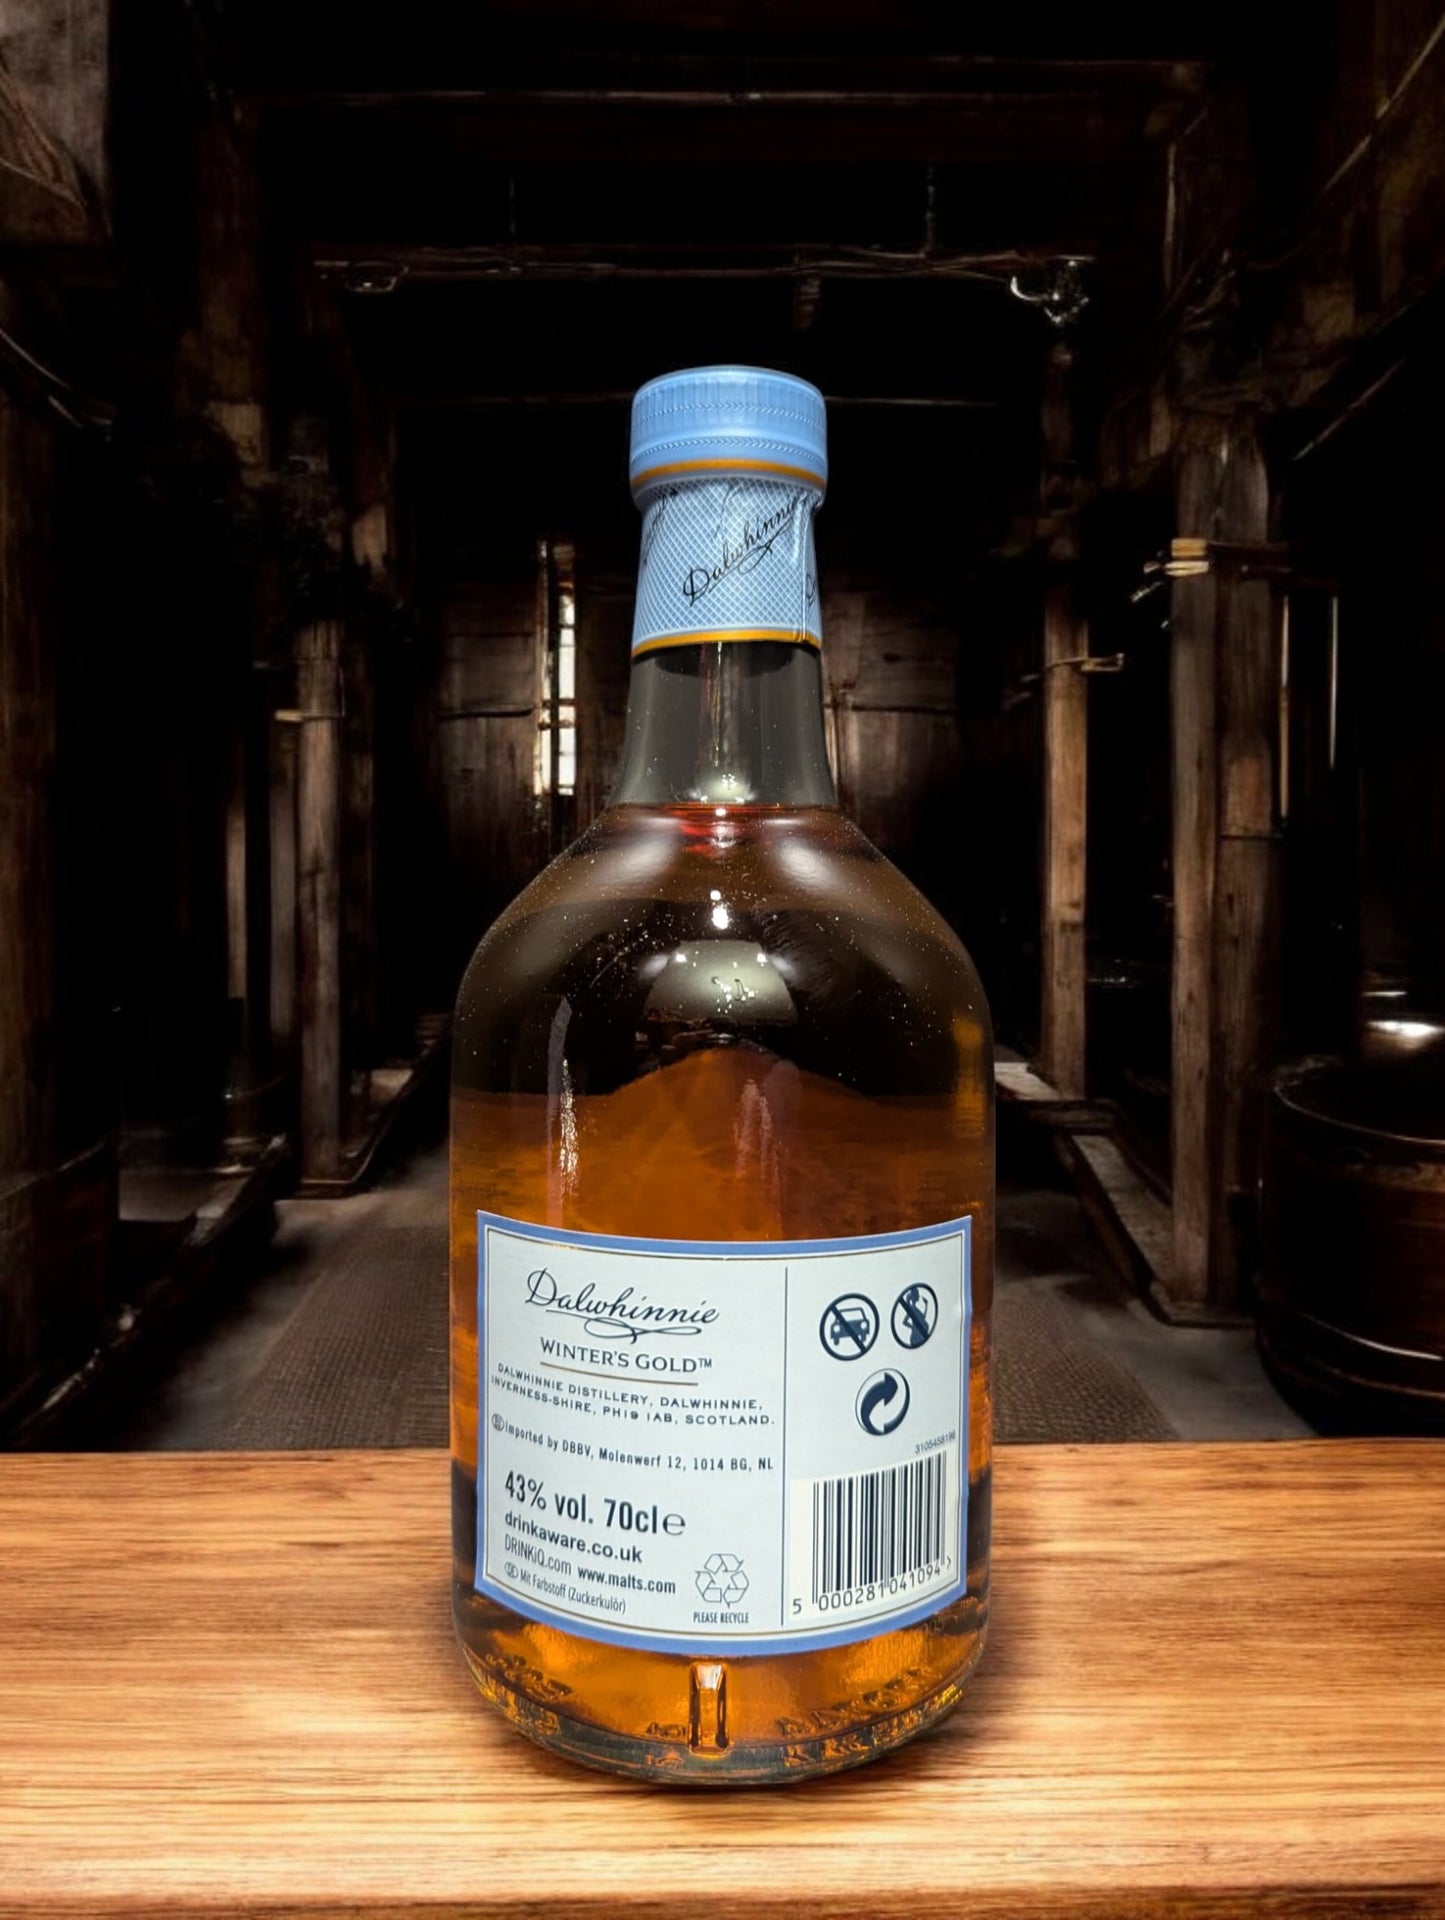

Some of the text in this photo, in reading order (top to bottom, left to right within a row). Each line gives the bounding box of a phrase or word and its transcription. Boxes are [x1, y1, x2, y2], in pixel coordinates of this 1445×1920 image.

[525, 1267, 720, 1345] Dalwhinnie
[540, 1336, 629, 1368] WINTER'S
[491, 1375, 597, 1415] INVERNESS-SHIRE,
[685, 1415, 775, 1425] SCOTLAND.
[498, 1362, 762, 1410] DALWHINNIE DISTILLERY, DALWHINNIE,
[547, 1435, 558, 1452] by
[562, 1439, 594, 1460] DBBV,
[599, 1447, 661, 1467] Molenwerf
[667, 1455, 687, 1471] 12,
[693, 1457, 724, 1471] 1014
[730, 1457, 752, 1472] BG,
[758, 1457, 774, 1470] NL
[505, 1470, 547, 1510] 43%
[554, 1493, 594, 1524] vol.
[505, 1511, 643, 1564] drinkaware.co.uk
[504, 1534, 677, 1594] DRINKiQ.com www.malts.com
[532, 1574, 567, 1599] Farbstoff
[567, 1587, 627, 1615] (Zuckerkulör)
[693, 1611, 749, 1624] PLEASE RECYCLE
